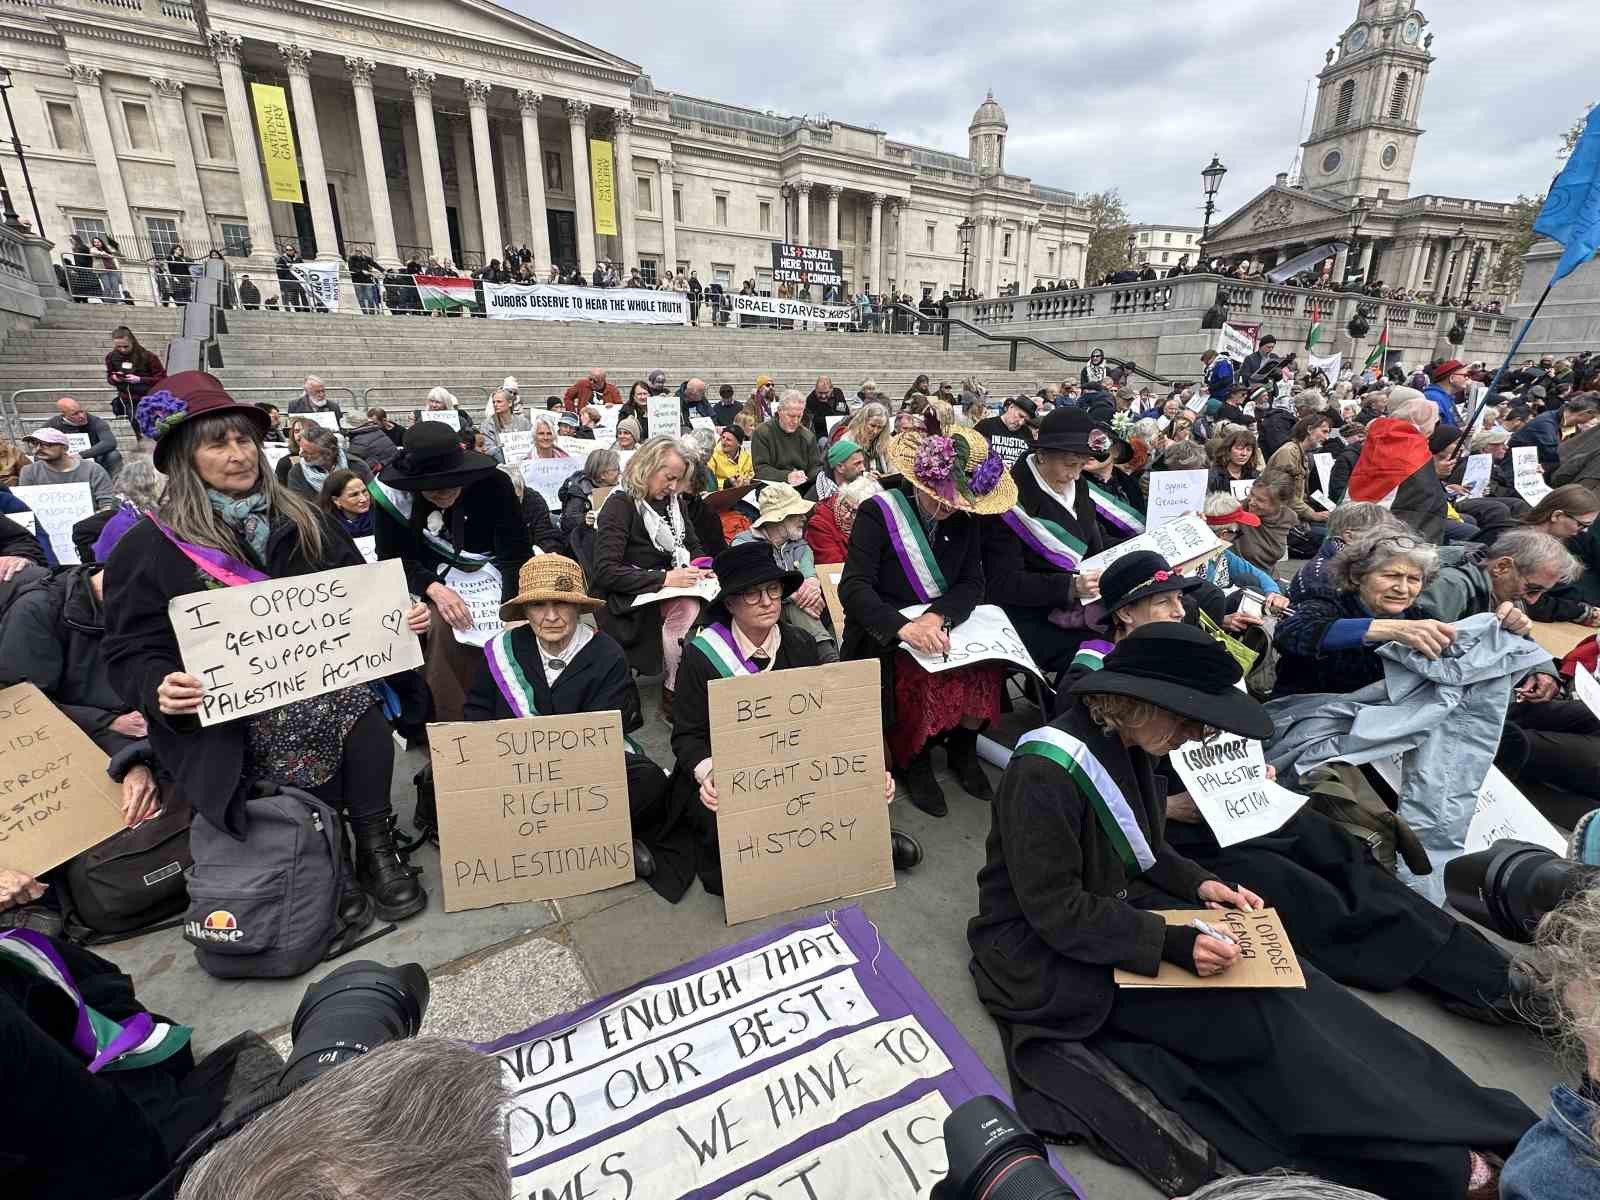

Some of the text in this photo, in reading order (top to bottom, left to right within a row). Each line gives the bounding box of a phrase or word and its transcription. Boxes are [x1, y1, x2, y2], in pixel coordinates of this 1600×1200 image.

[264, 104, 280, 160] NATIONAL
[273, 104, 291, 160] GALLERY
[780, 257, 836, 273] HERE TO KILL
[491, 294, 682, 314] JURORS DESERVE TO HEAR THE WHOLE TRUTH
[734, 298, 776, 313] ISRAEL
[778, 303, 826, 319] STARVES
[185, 579, 348, 630] I OPPOSE
[225, 608, 353, 656] GENOCIDE
[201, 643, 393, 719] PALESTINE ACTION
[203, 633, 351, 691] I SUPPORT
[737, 691, 824, 722] BE ON
[0, 725, 50, 754] IDE
[451, 725, 615, 765] I SUPPORT
[759, 729, 802, 755] THE
[1188, 739, 1249, 770] SUPPORT
[512, 759, 562, 783] THE
[732, 754, 868, 794] RIGHT SIDE
[503, 785, 609, 818] RIGHTS
[785, 792, 816, 816] OF
[1225, 791, 1270, 819] ACTION
[518, 820, 549, 836] OF
[737, 817, 857, 863] HISTORY
[454, 842, 630, 887] PALESTINIANS
[1255, 924, 1293, 977] OPPOSE
[496, 931, 842, 1083] NOT ENOUGH THAT
[507, 1091, 576, 1157] DO
[604, 1042, 702, 1110] OUR
[677, 1098, 749, 1166] WE
[764, 1048, 864, 1129] HAVE
[874, 1027, 930, 1066] TO
